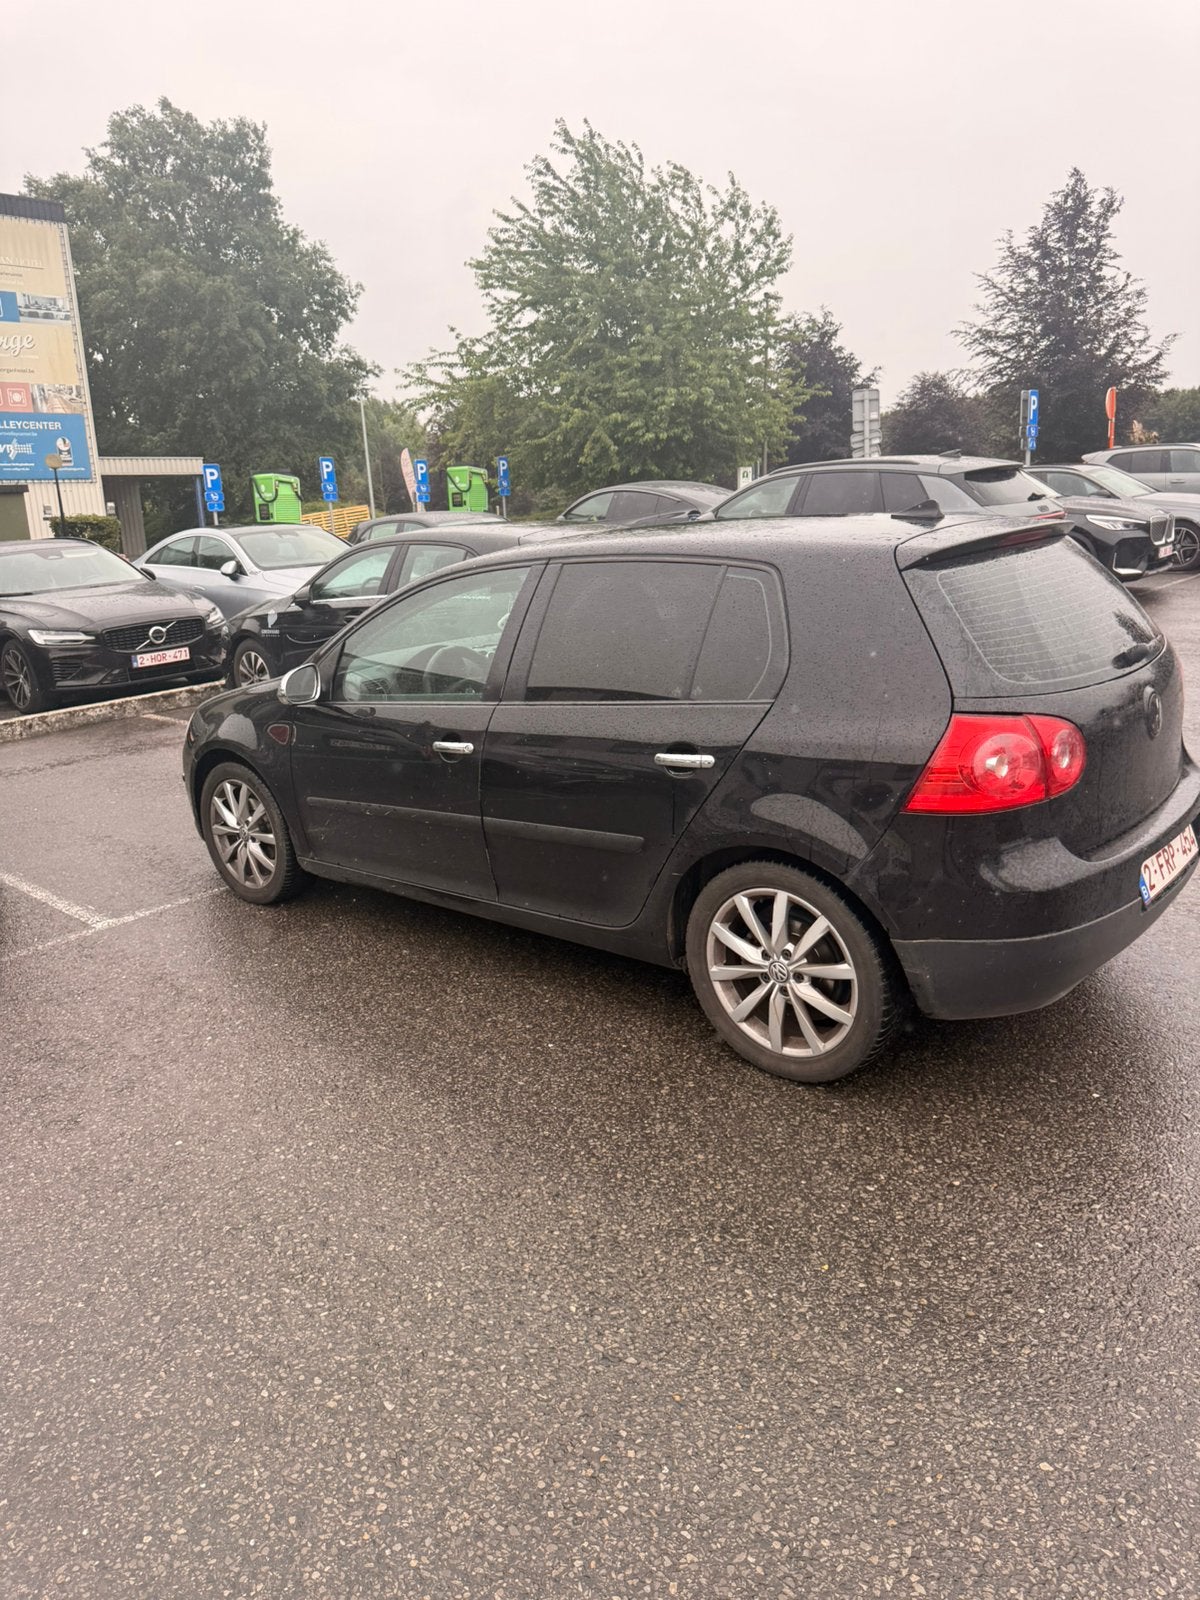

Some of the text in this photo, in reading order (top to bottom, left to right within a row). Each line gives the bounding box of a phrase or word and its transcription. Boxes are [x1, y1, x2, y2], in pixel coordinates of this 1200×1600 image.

[1030, 395, 1038, 420] P
[205, 468, 219, 488] P
[322, 461, 333, 480] P
[416, 463, 427, 481] P
[499, 460, 508, 477] P
